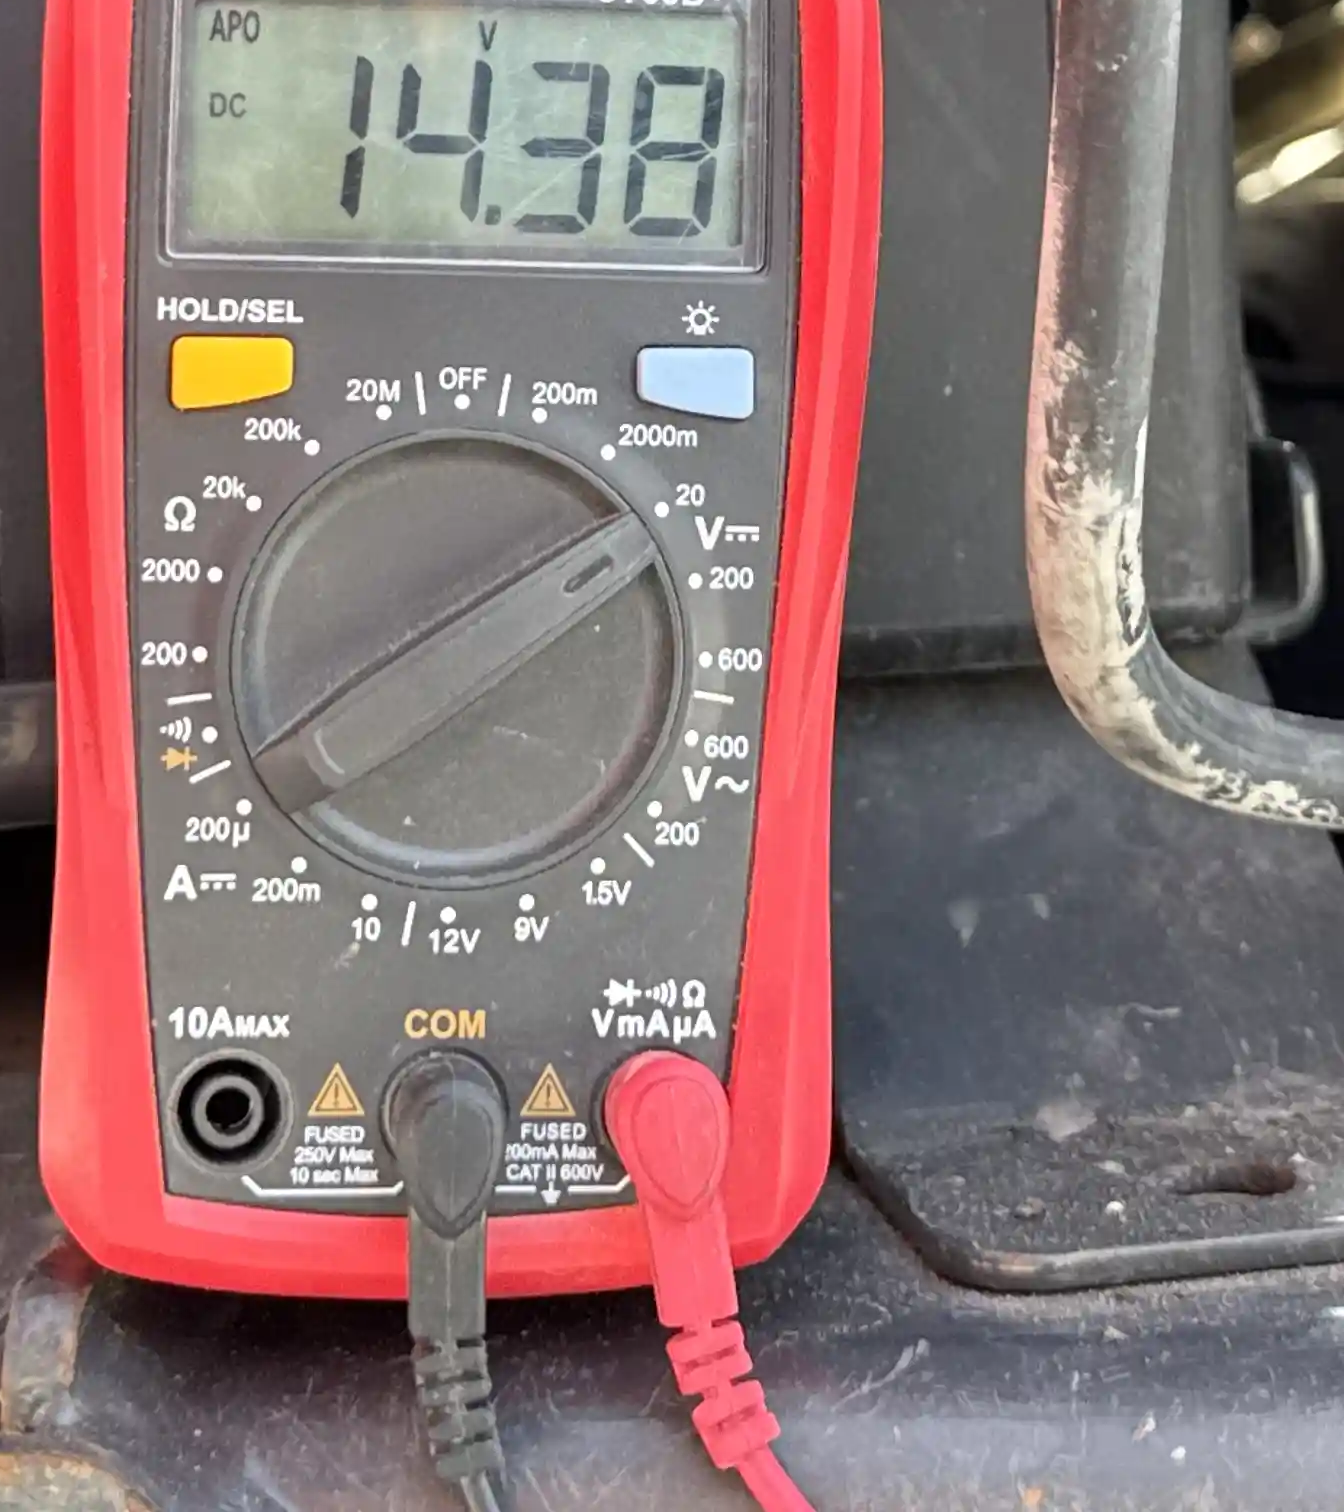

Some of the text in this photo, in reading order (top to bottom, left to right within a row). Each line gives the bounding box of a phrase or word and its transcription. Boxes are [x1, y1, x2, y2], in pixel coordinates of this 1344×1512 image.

[208, 9, 262, 44] APO
[478, 19, 499, 52] V
[208, 92, 248, 119] DC
[339, 54, 727, 238] 14.38
[156, 296, 304, 324] HOLD/SEL
[345, 378, 401, 402] 20M
[438, 366, 488, 390] OFF
[531, 381, 598, 406] 200m
[243, 417, 302, 441] 200k
[618, 423, 698, 448] 2000m
[202, 475, 247, 499] 20k
[675, 483, 706, 506] 20
[141, 557, 201, 583] 2000
[708, 567, 755, 590] 200
[141, 642, 188, 666] 200
[717, 648, 763, 672] 600
[703, 735, 750, 760] 600
[184, 817, 251, 848] 200µ
[654, 822, 700, 846] 200
[251, 878, 321, 903] 200m
[581, 880, 632, 906] 1.5V
[351, 917, 381, 942] 10
[428, 928, 481, 954] 12V
[513, 916, 550, 942] 9V
[404, 1008, 487, 1039] COM
[304, 1125, 366, 1144] FUSED
[520, 1122, 587, 1141] FUSED
[294, 1147, 374, 1164] 250V Max
[561, 1143, 597, 1160] Max
[290, 1167, 379, 1185] 10 sec Max
[506, 1163, 540, 1181] CAT
[559, 1163, 605, 1181] 600V
